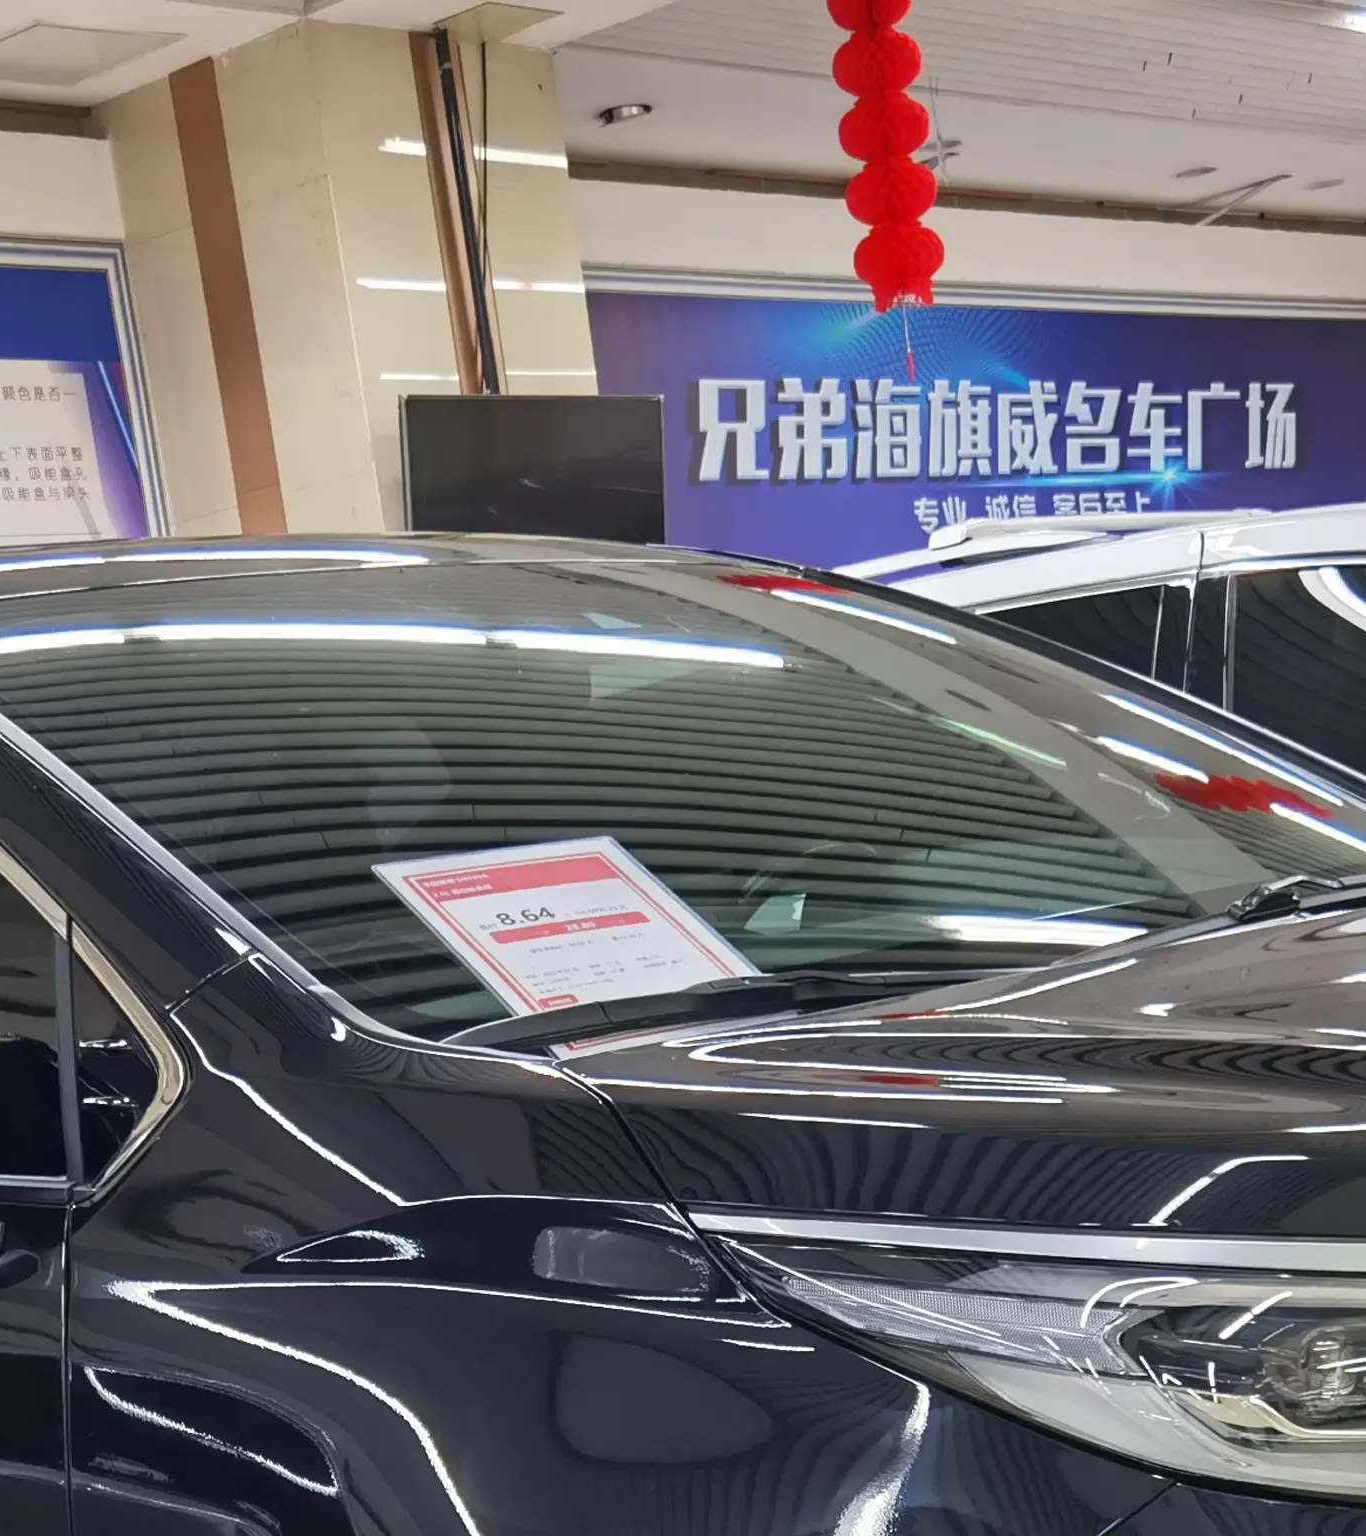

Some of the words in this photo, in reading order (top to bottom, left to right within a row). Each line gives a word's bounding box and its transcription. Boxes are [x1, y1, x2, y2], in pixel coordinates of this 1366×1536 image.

[699, 377, 1299, 483] 兄弟海旗威名车广场
[913, 495, 968, 534] 专业
[496, 906, 555, 926] 8.64
